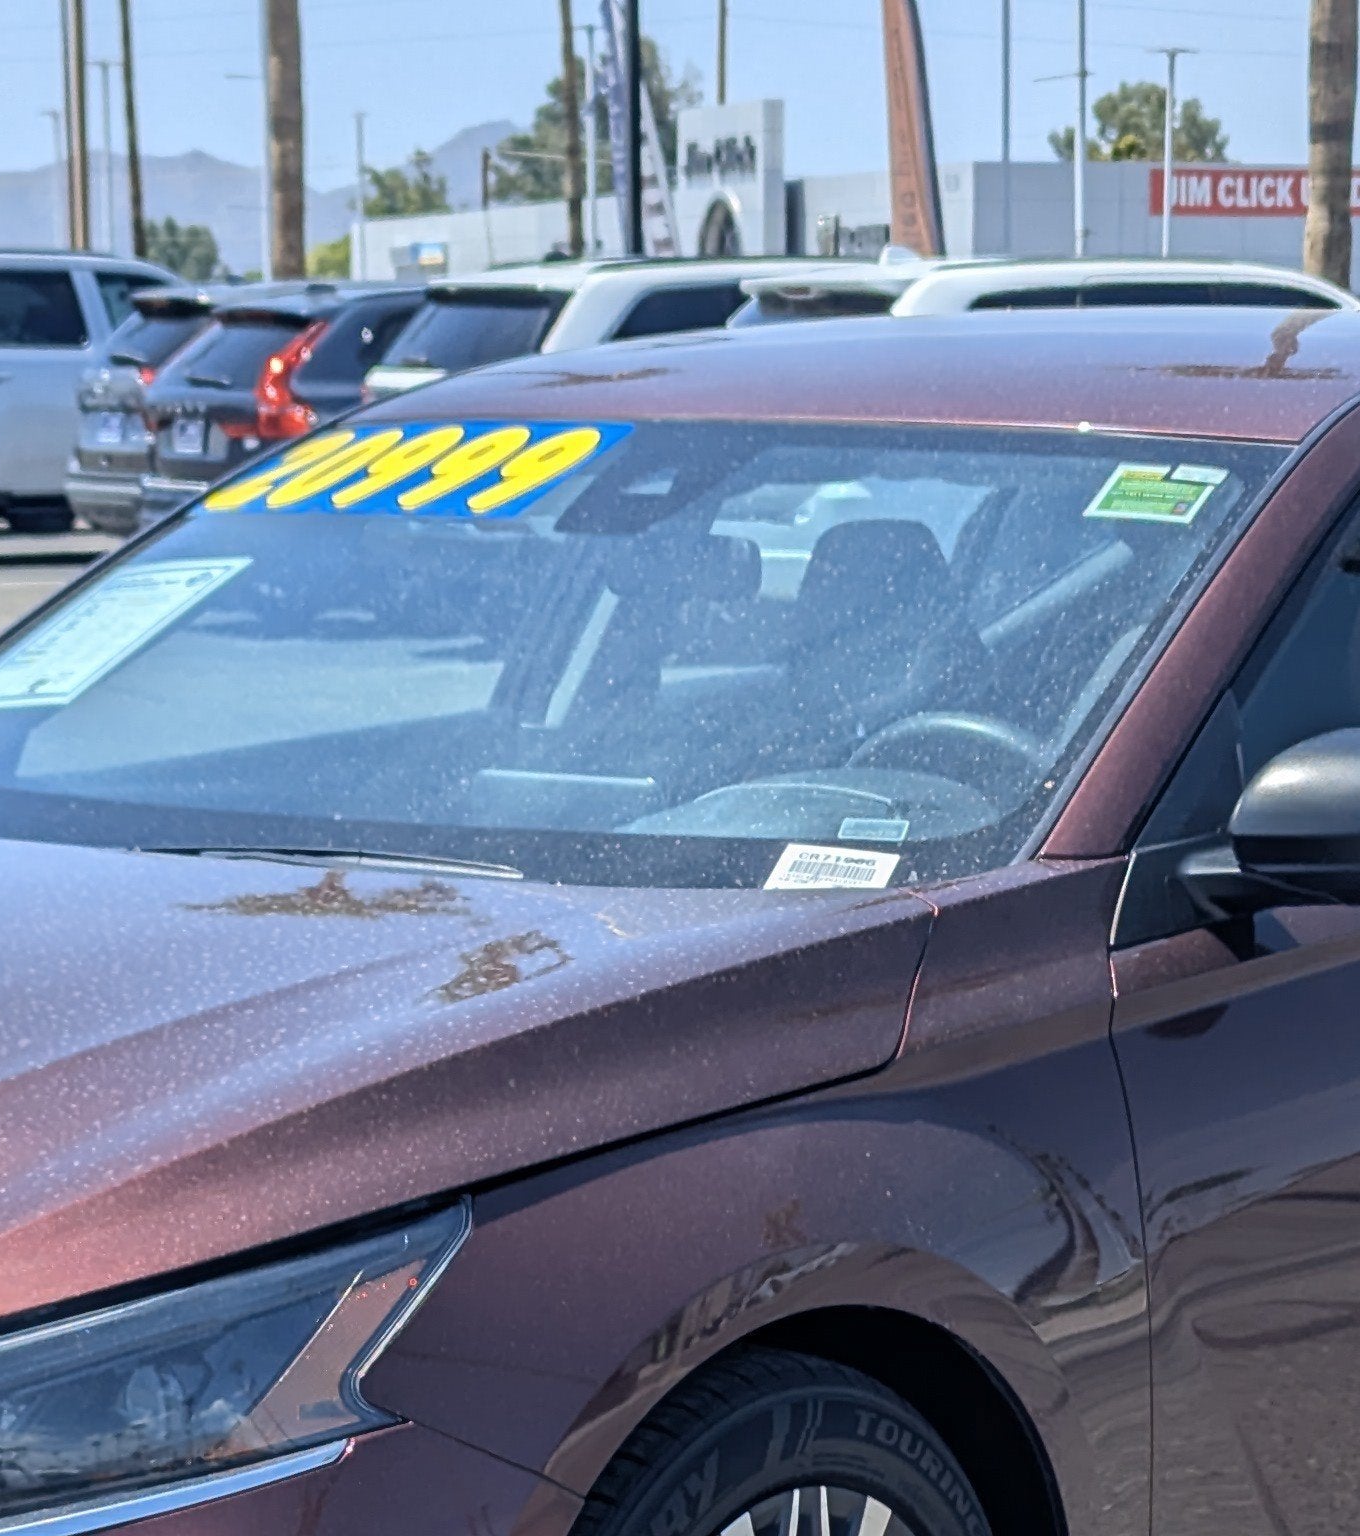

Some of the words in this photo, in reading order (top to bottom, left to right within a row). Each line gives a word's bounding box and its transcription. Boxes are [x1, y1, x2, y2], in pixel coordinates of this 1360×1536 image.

[1167, 176, 1212, 207] JIM
[1217, 176, 1294, 208] CLICK
[204, 426, 601, 513] 20999
